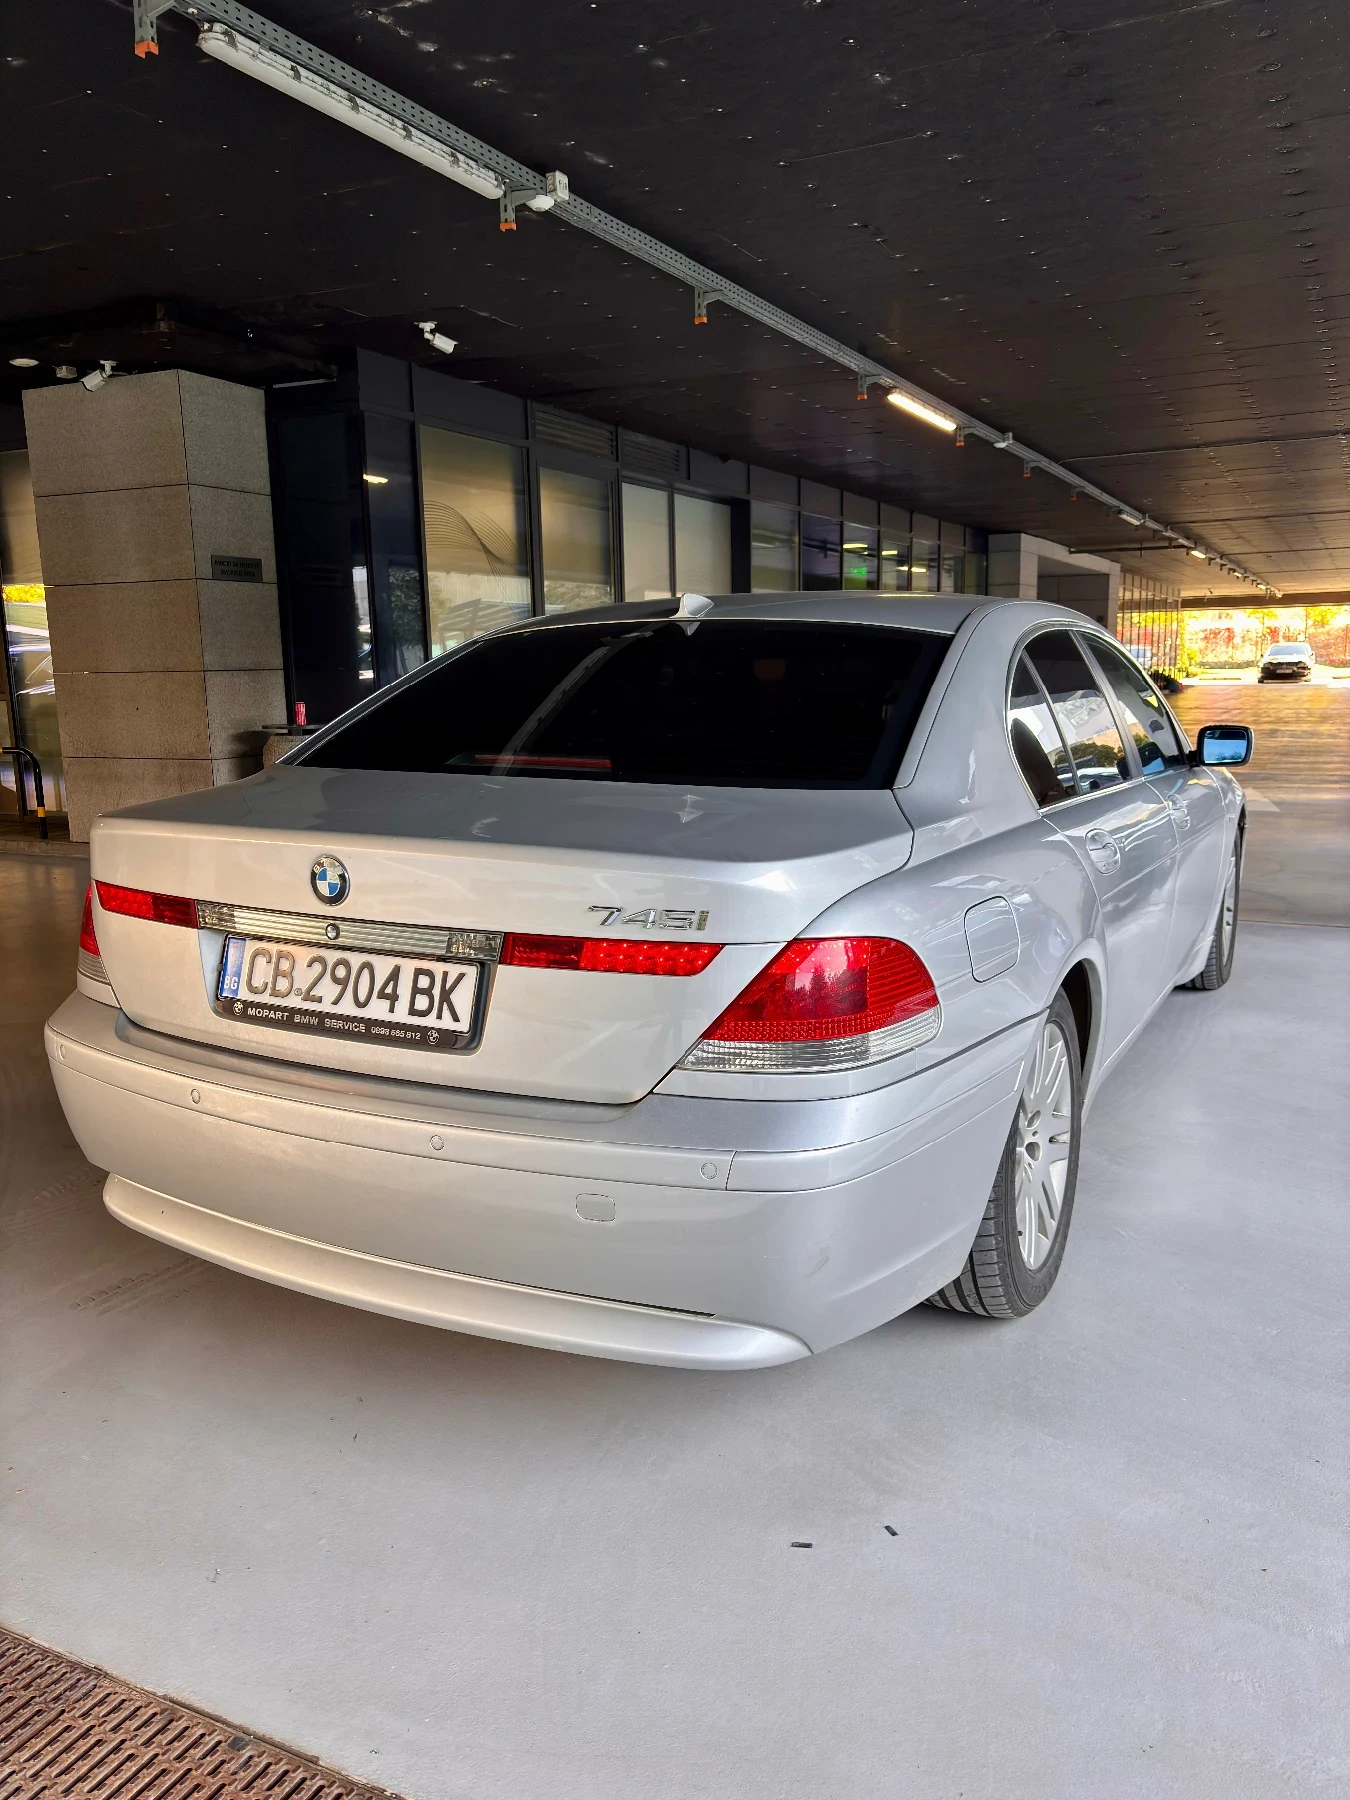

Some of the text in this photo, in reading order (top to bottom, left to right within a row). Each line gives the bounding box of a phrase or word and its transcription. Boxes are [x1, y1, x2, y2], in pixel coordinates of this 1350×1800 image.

[587, 905, 709, 931] 745i
[223, 975, 239, 990] BG
[246, 946, 466, 1022] CB 2904 BK
[247, 1007, 290, 1021] MOPART
[293, 1014, 319, 1026] BMW
[324, 1018, 366, 1033] SERVICE
